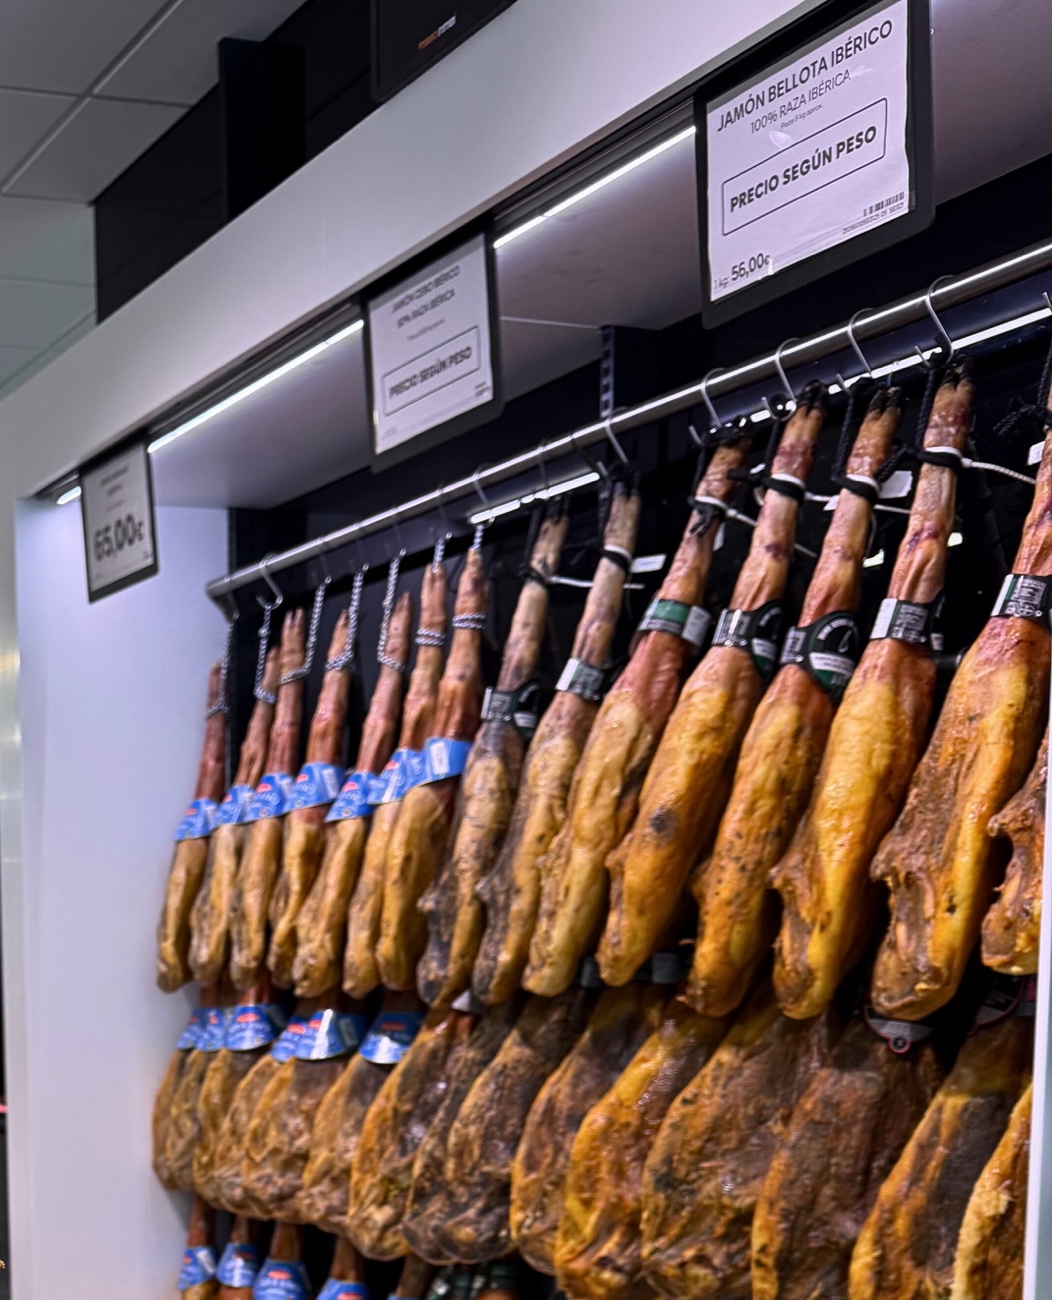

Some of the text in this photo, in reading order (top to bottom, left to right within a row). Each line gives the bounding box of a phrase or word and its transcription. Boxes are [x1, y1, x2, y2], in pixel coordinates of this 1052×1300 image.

[717, 20, 893, 132] JAMÓN BELLOTA IBÉRICO
[750, 69, 851, 134] 100% RAZA IBÉRICA
[730, 126, 877, 213] PRECIO SEGÚN PESO
